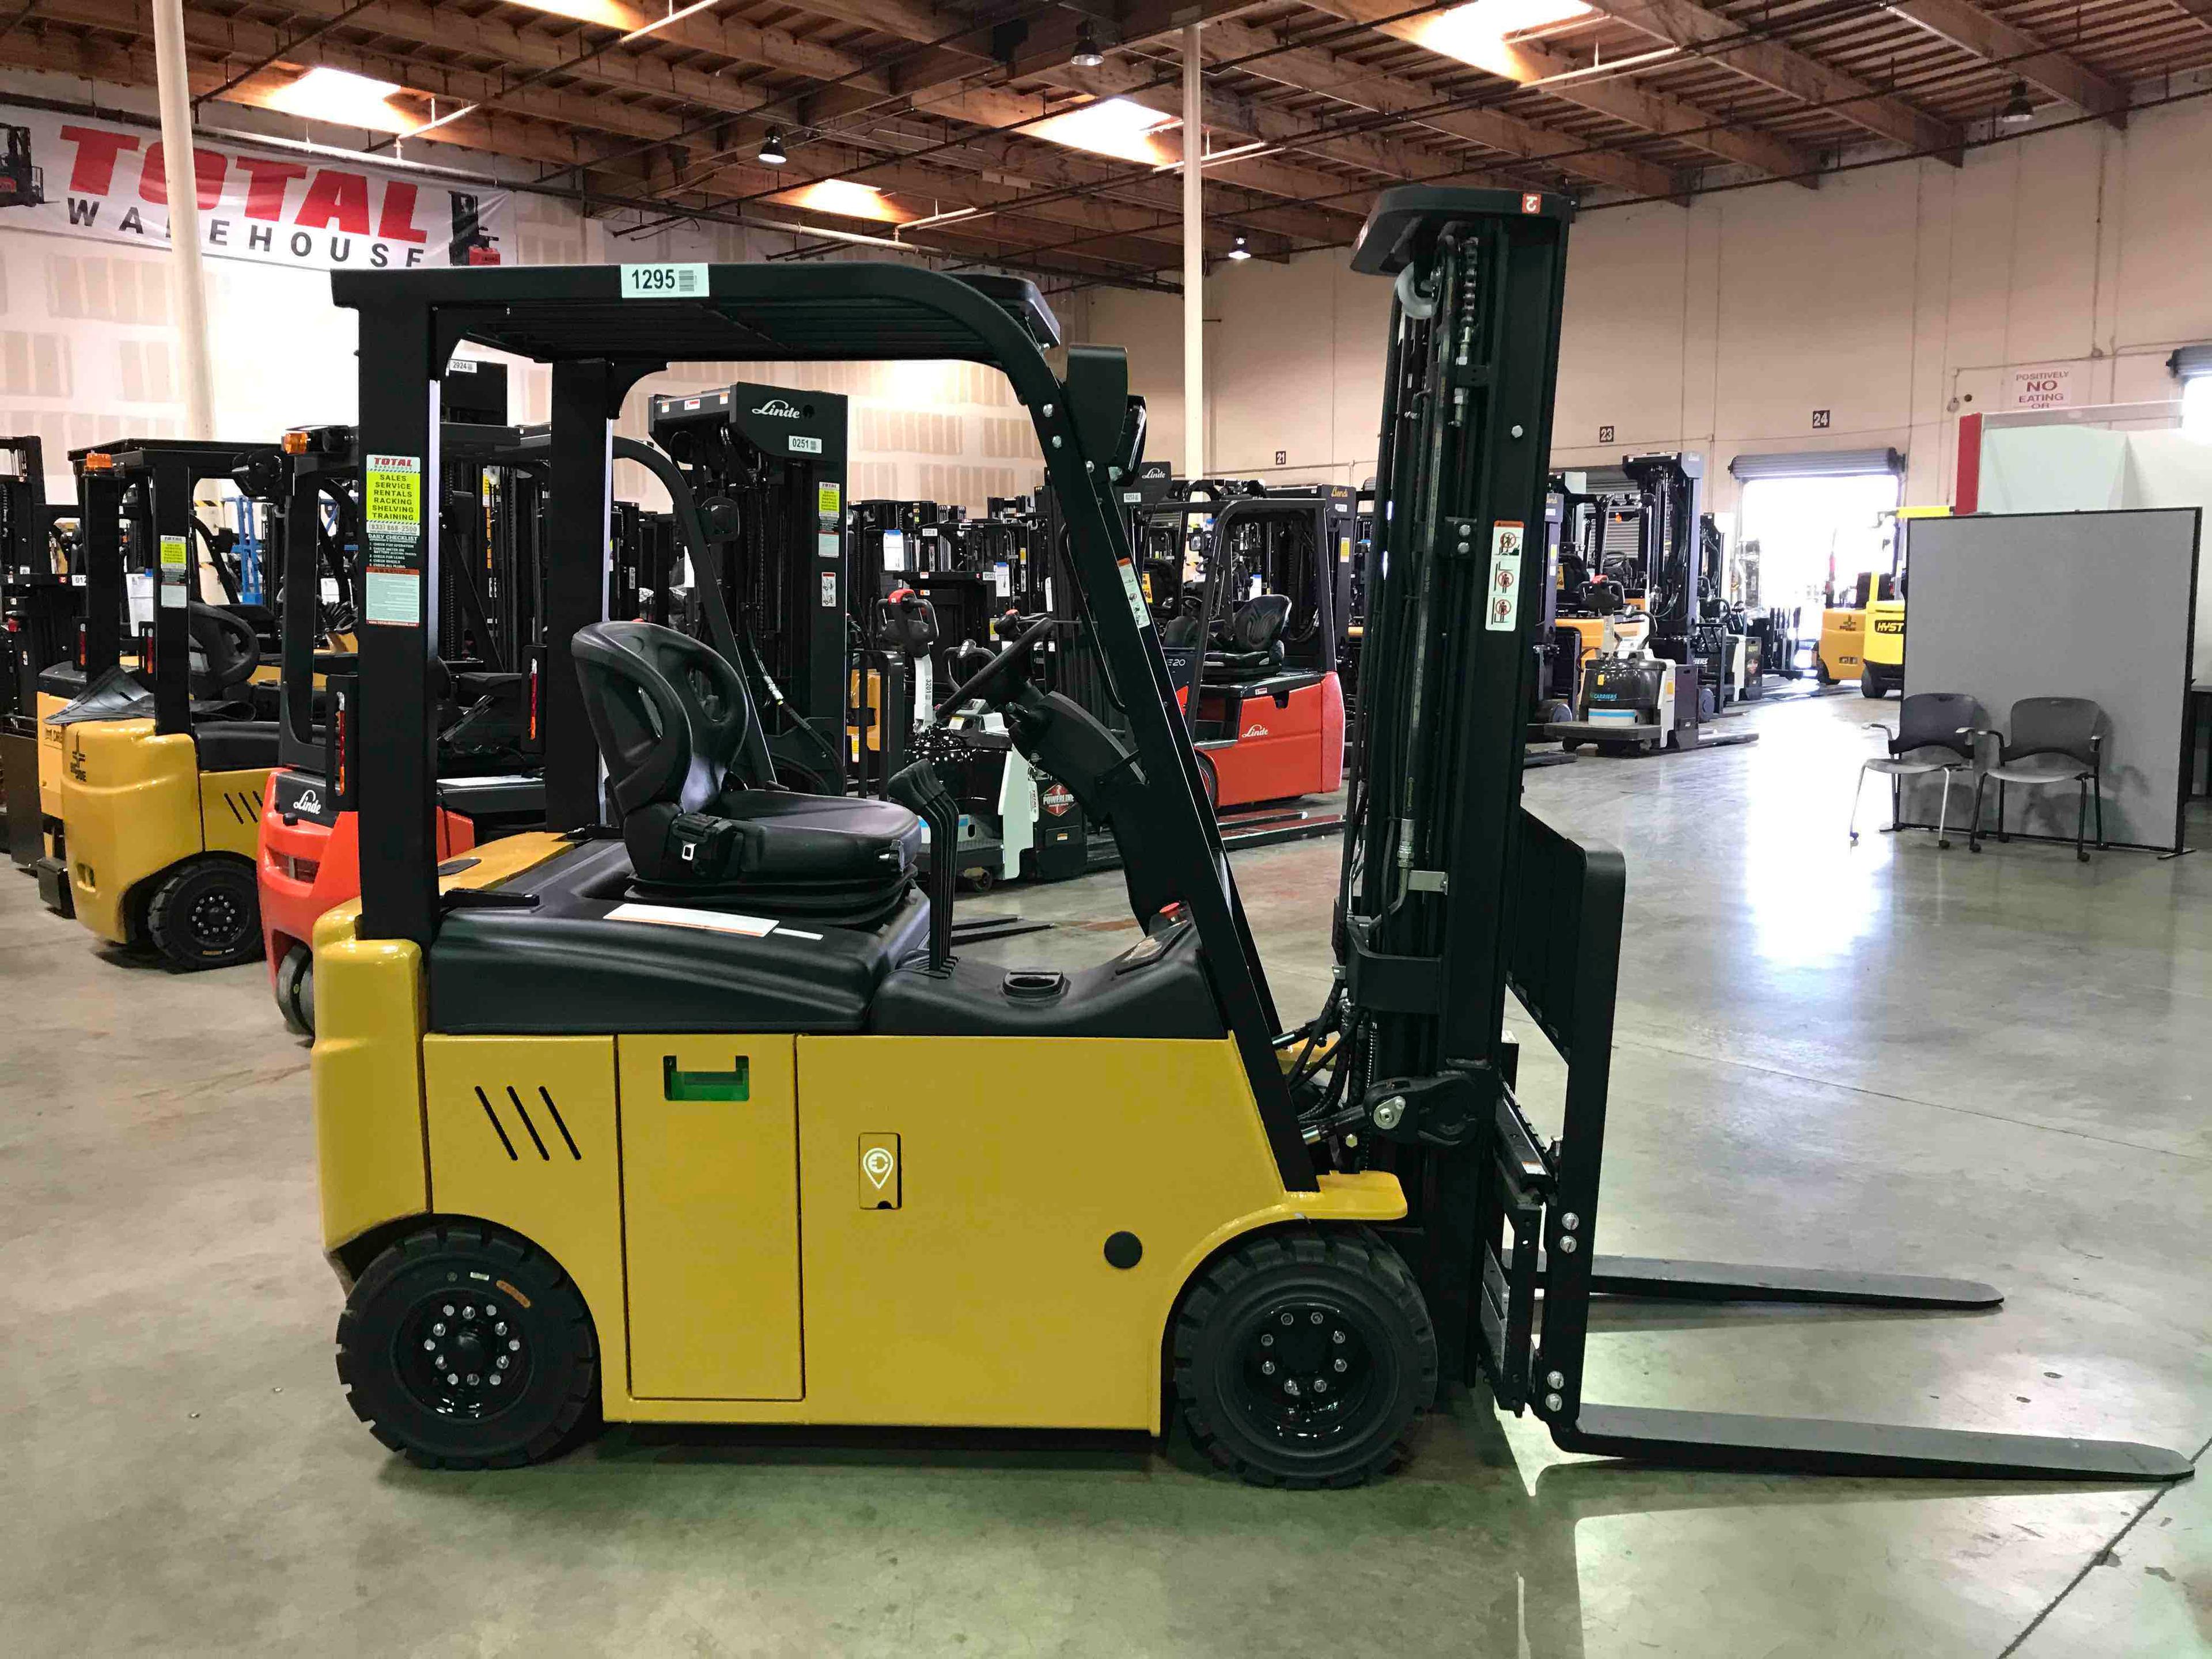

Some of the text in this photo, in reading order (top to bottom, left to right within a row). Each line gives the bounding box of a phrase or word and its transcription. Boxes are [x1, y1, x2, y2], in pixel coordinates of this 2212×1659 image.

[67, 198, 425, 267] WAEHOUSE
[632, 269, 675, 289] 1295
[2016, 371, 2069, 381] POSITIVELY
[2027, 380, 2057, 392] NO
[2019, 393, 2063, 403] EATING
[752, 400, 800, 418] Linde
[1813, 412, 1828, 426] 24
[1601, 428, 1612, 441] 23
[793, 438, 808, 448] 0251
[374, 457, 412, 467] TOTAL
[1277, 452, 1285, 464] 21
[1142, 468, 1165, 479] Linde
[374, 497, 412, 505] RACKING
[372, 505, 414, 513] SHELVING
[372, 513, 414, 521] TRAINING
[1243, 725, 1268, 737] Linde
[293, 790, 321, 814] Linde
